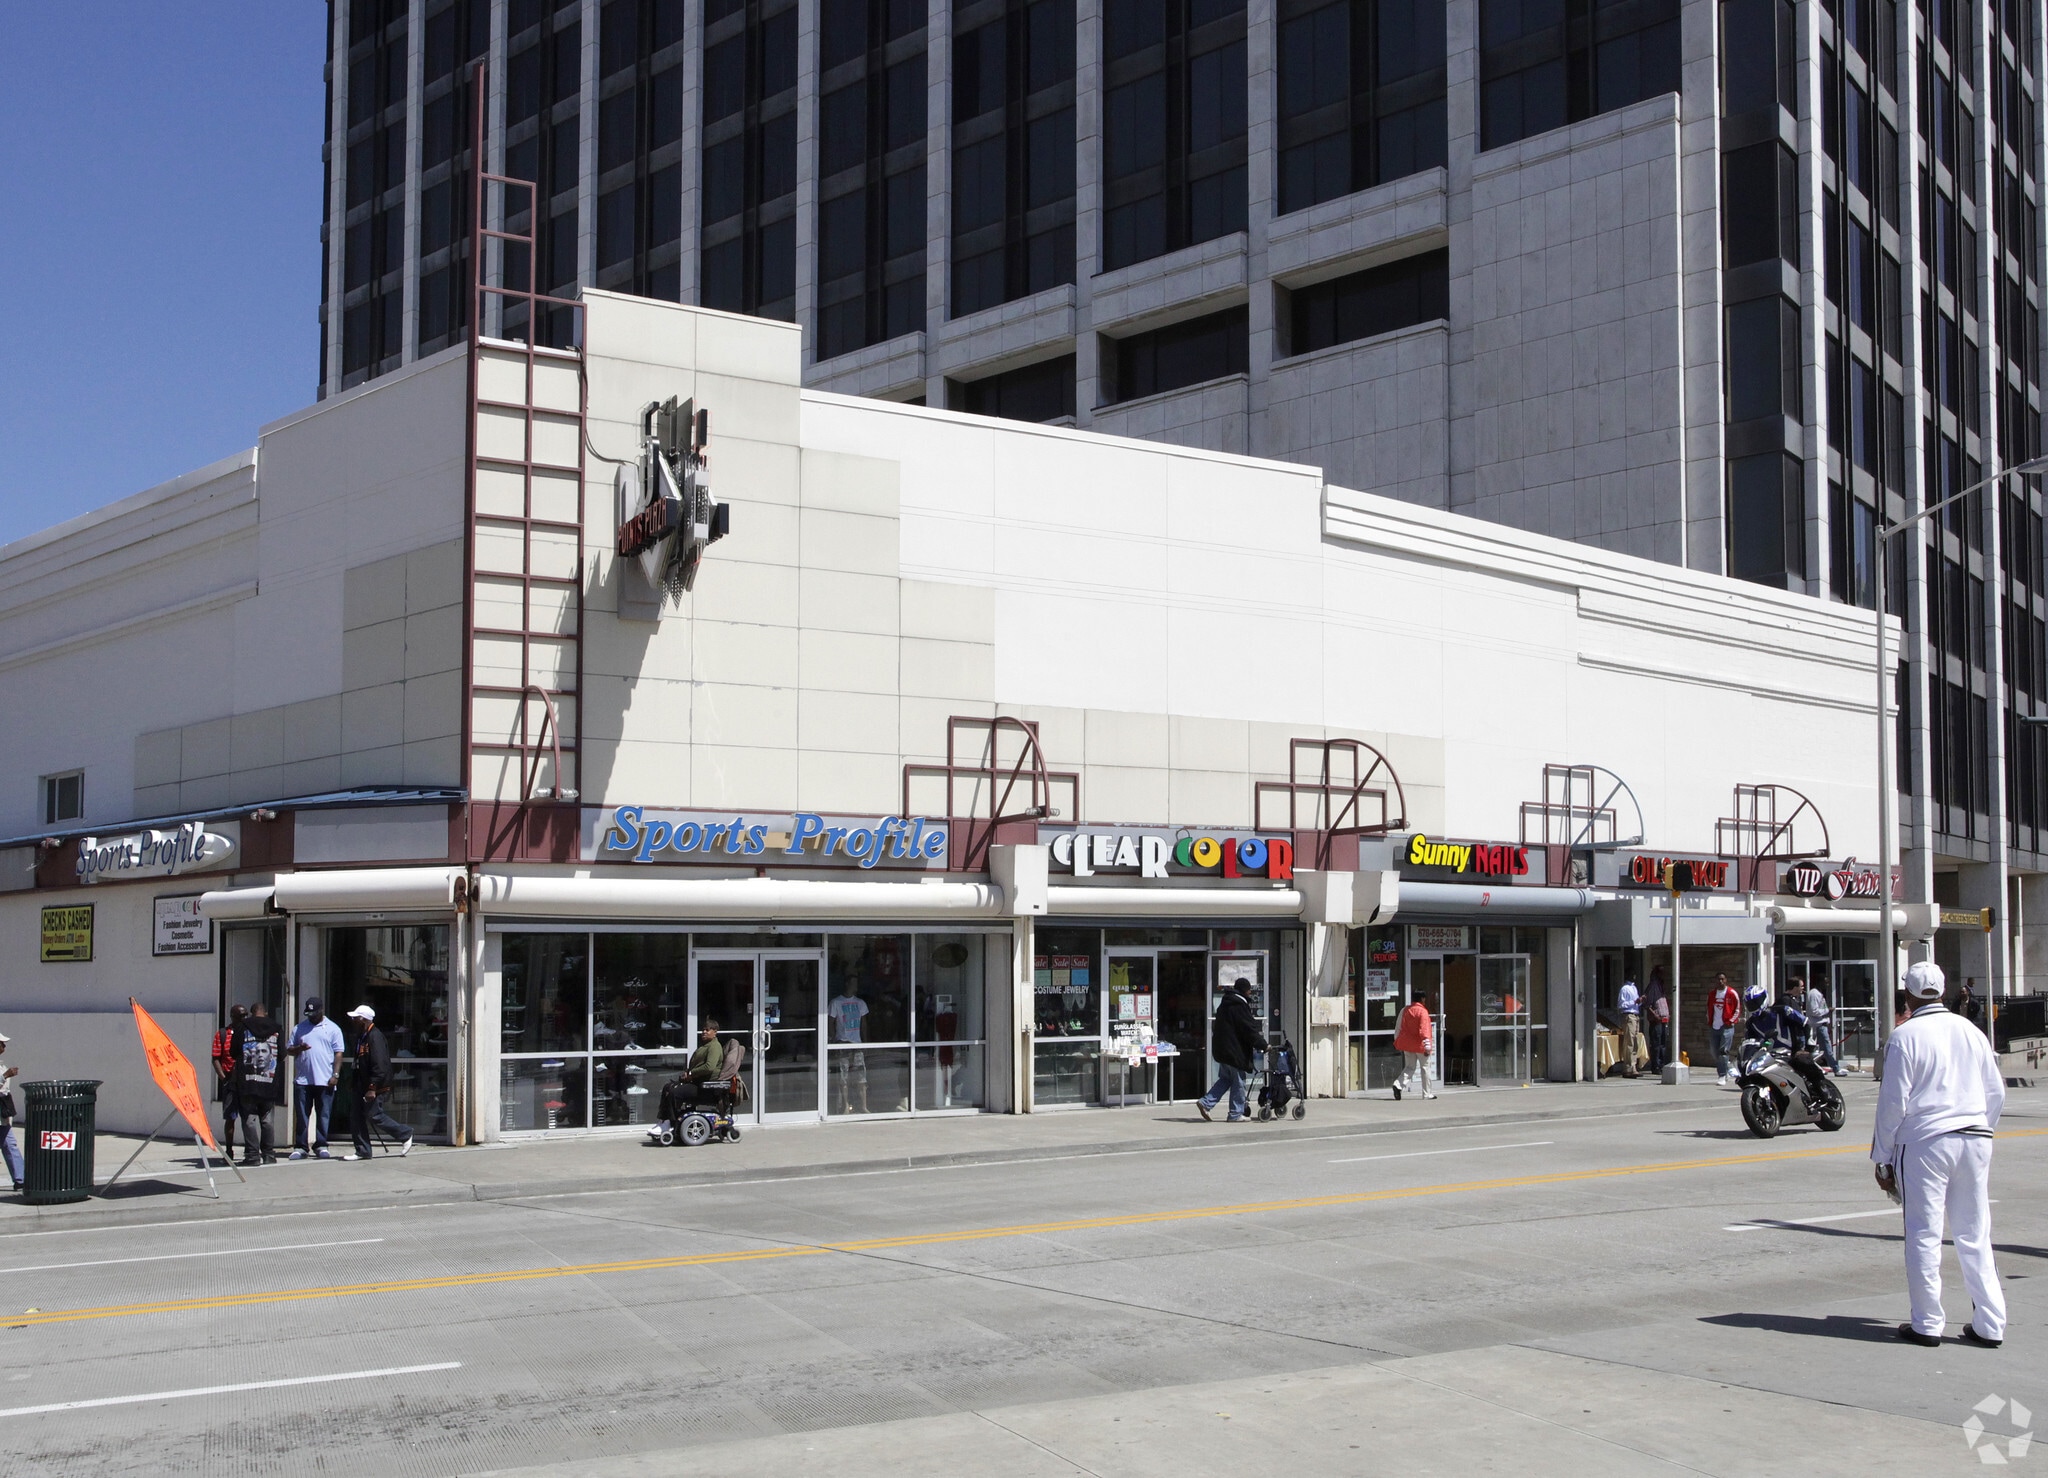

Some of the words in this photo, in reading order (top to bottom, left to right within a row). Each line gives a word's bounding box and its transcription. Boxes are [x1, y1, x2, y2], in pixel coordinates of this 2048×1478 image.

[645, 496, 667, 539] PLAZA
[607, 806, 768, 862] Sports
[785, 813, 946, 868] Profile
[76, 837, 134, 883] Sports
[136, 822, 206, 875] Profile
[1051, 834, 1169, 878] CLEAR
[1174, 837, 1293, 879] COLOR
[1410, 834, 1471, 873] Sunny
[1793, 868, 1821, 893] VIP
[1481, 893, 1490, 906] 27
[43, 911, 66, 932] CHECKS
[67, 909, 90, 930] CASHED
[163, 920, 181, 929] Fashion
[182, 919, 203, 928] Jewelry
[171, 931, 194, 940] Cosmetic
[158, 943, 176, 951] Fashion
[177, 941, 207, 950] Accessories
[1053, 958, 1068, 967] Sale
[1073, 958, 1088, 967] Sale
[1034, 986, 1062, 994] COSTUME
[1063, 985, 1090, 994] JEWELRY
